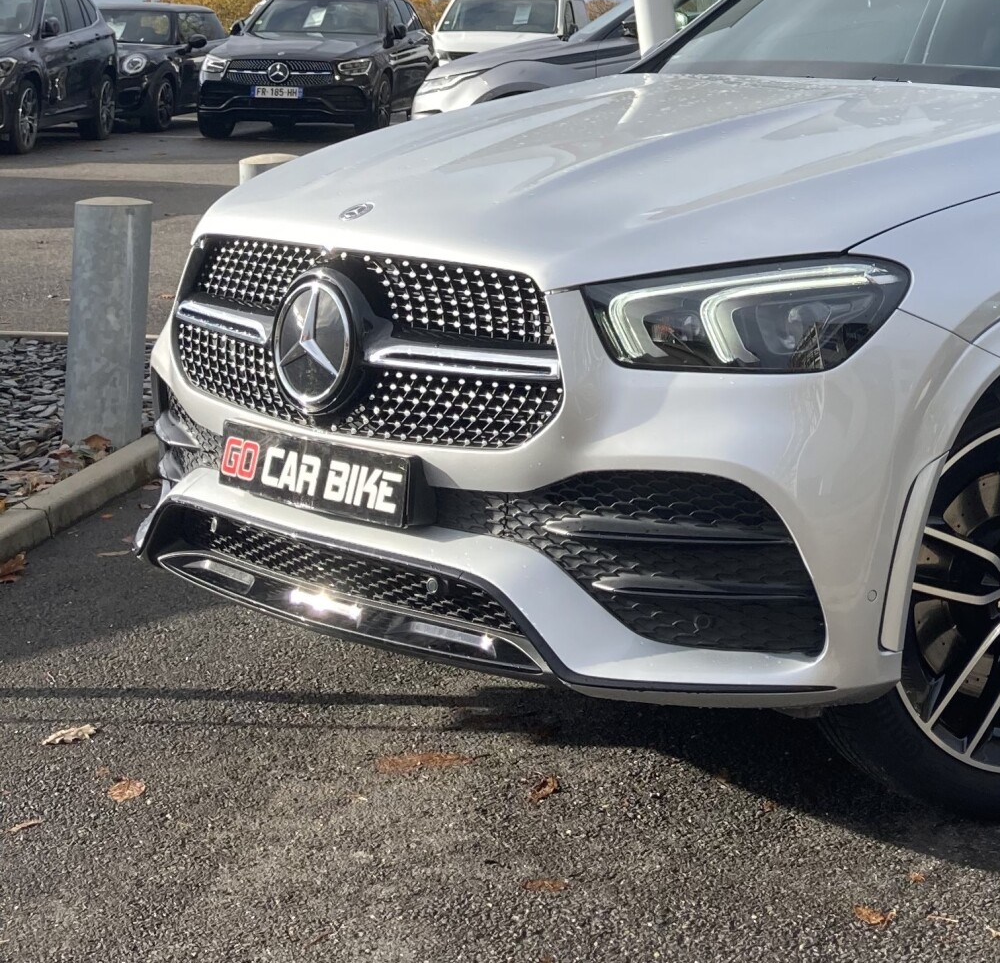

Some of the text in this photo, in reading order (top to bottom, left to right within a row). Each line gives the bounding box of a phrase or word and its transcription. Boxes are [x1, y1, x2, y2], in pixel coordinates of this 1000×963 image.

[220, 436, 403, 514] GO CAR BIKE
